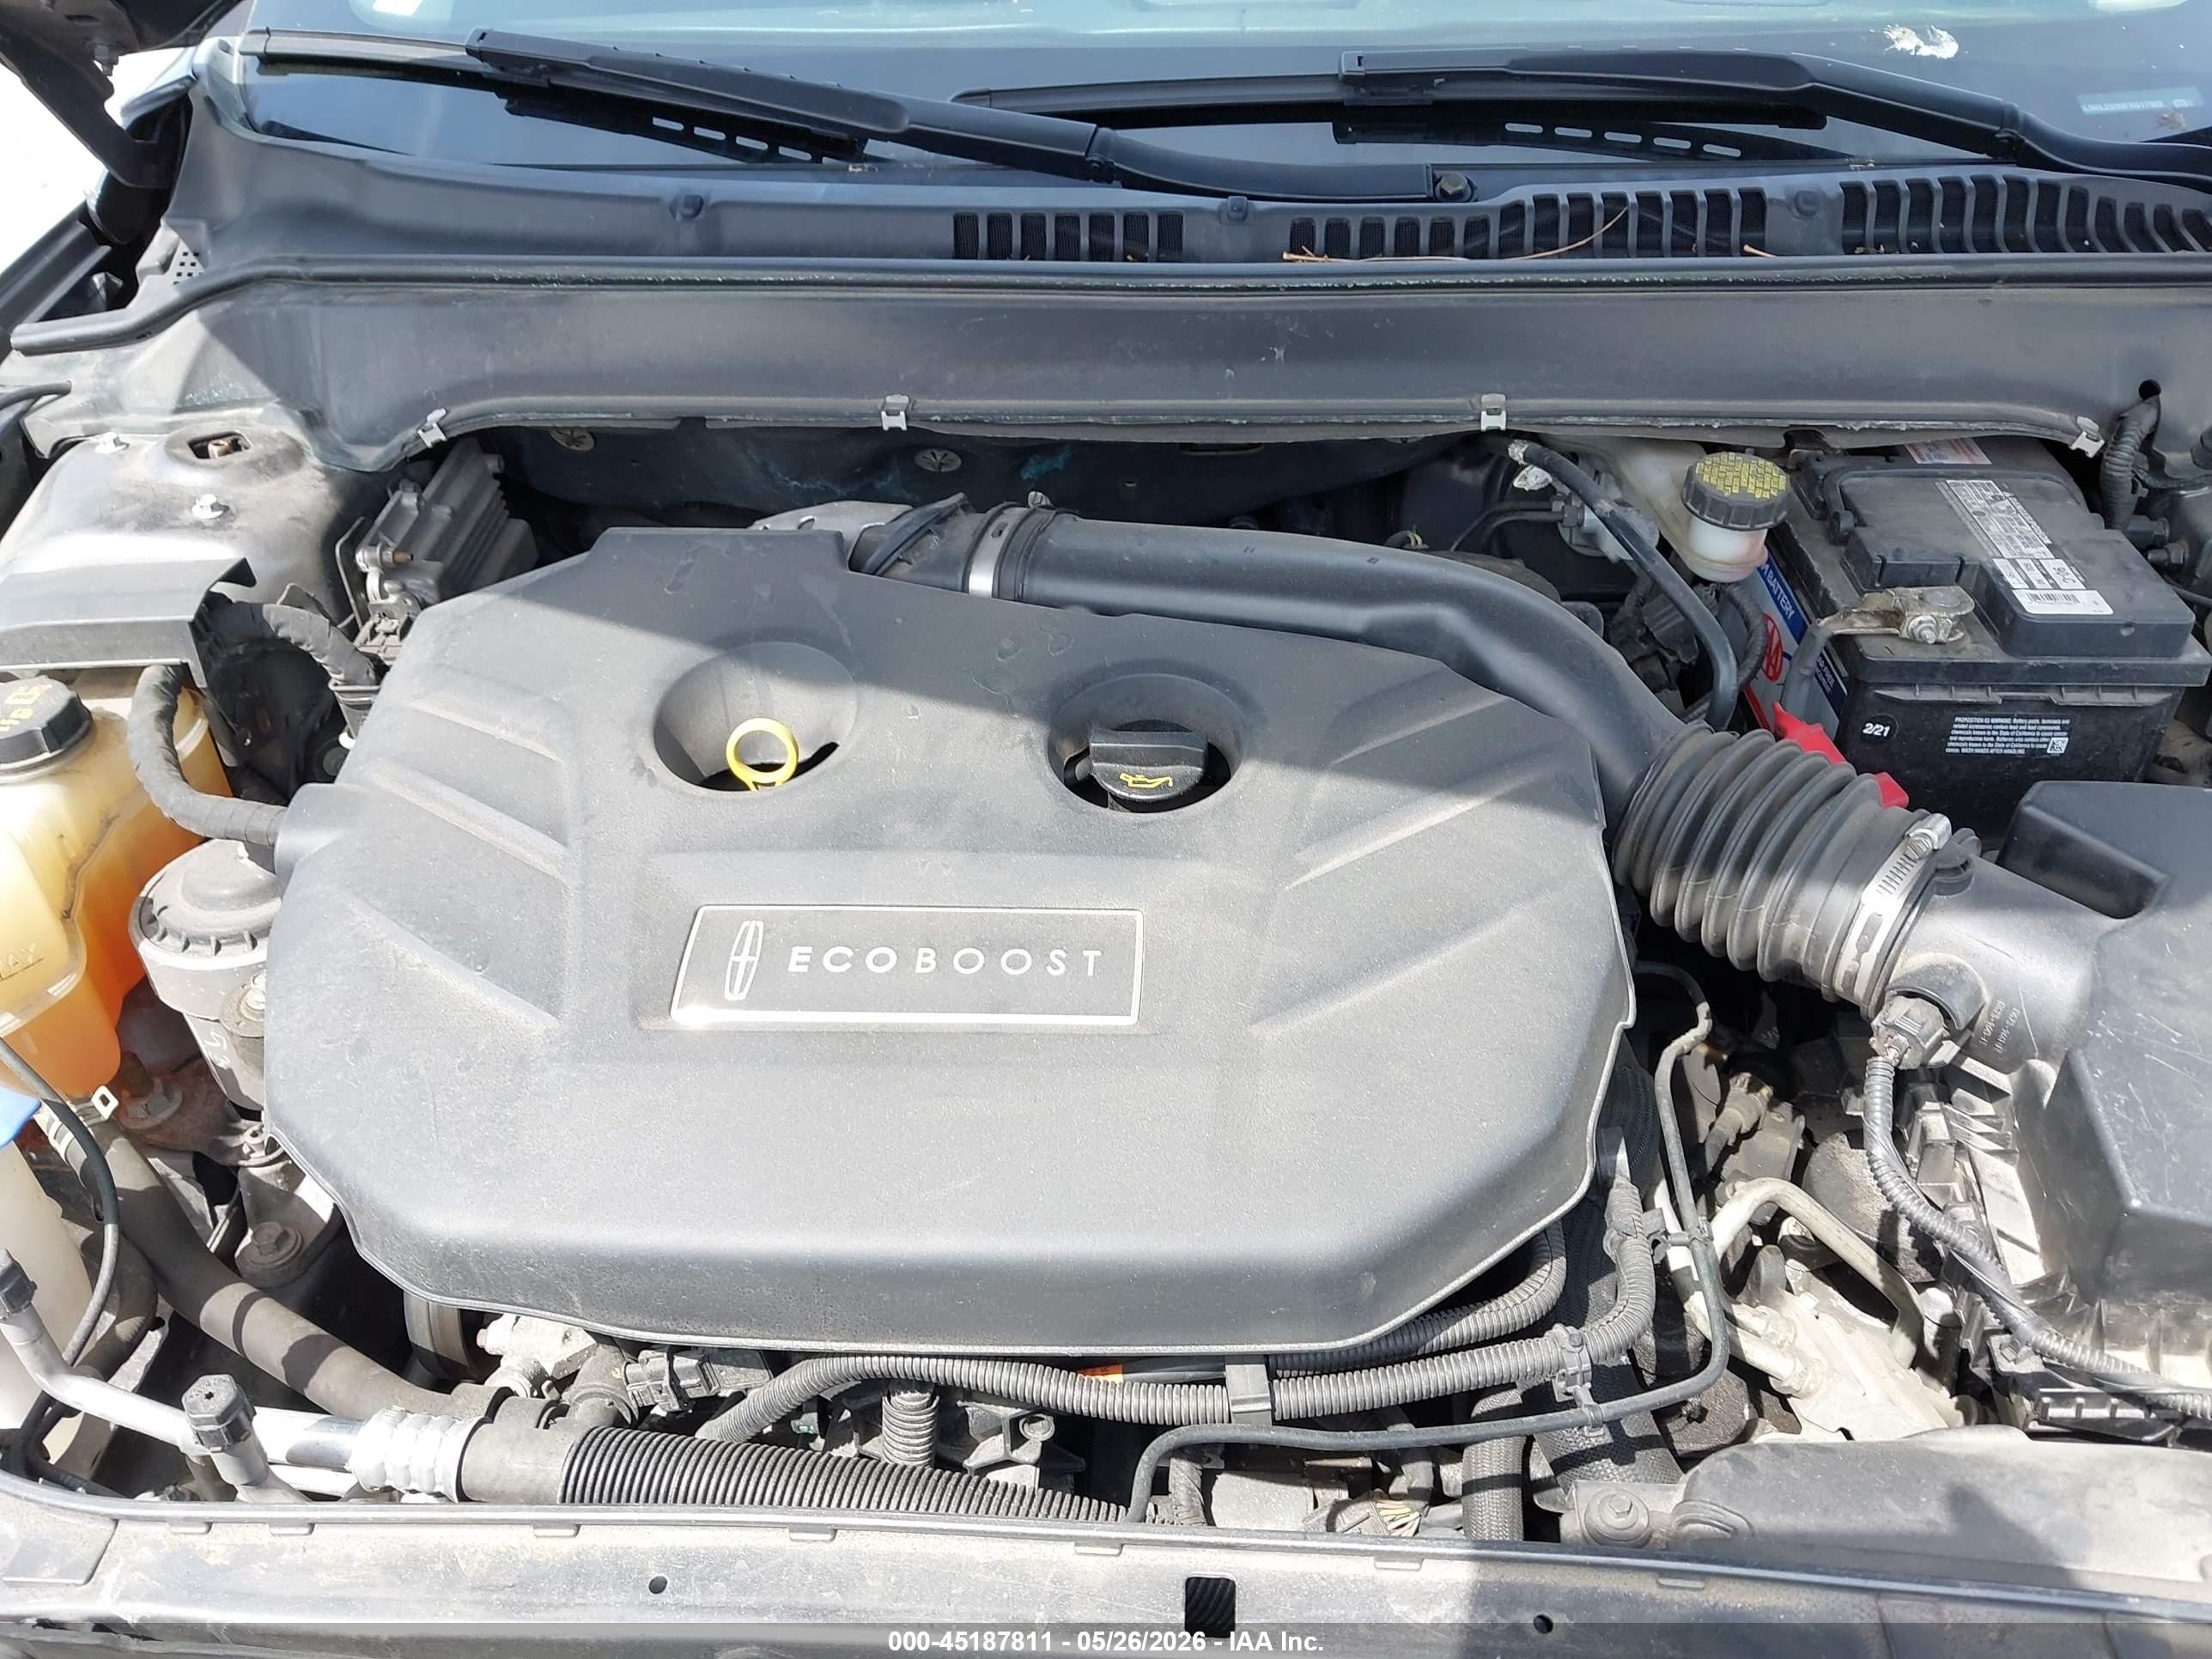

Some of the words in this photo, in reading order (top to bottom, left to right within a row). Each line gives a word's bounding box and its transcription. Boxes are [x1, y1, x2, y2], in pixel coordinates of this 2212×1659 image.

[1766, 570, 1795, 619] BATTERY
[1862, 722, 1890, 737] 2/21
[787, 945, 1102, 977] ECOBOOST
